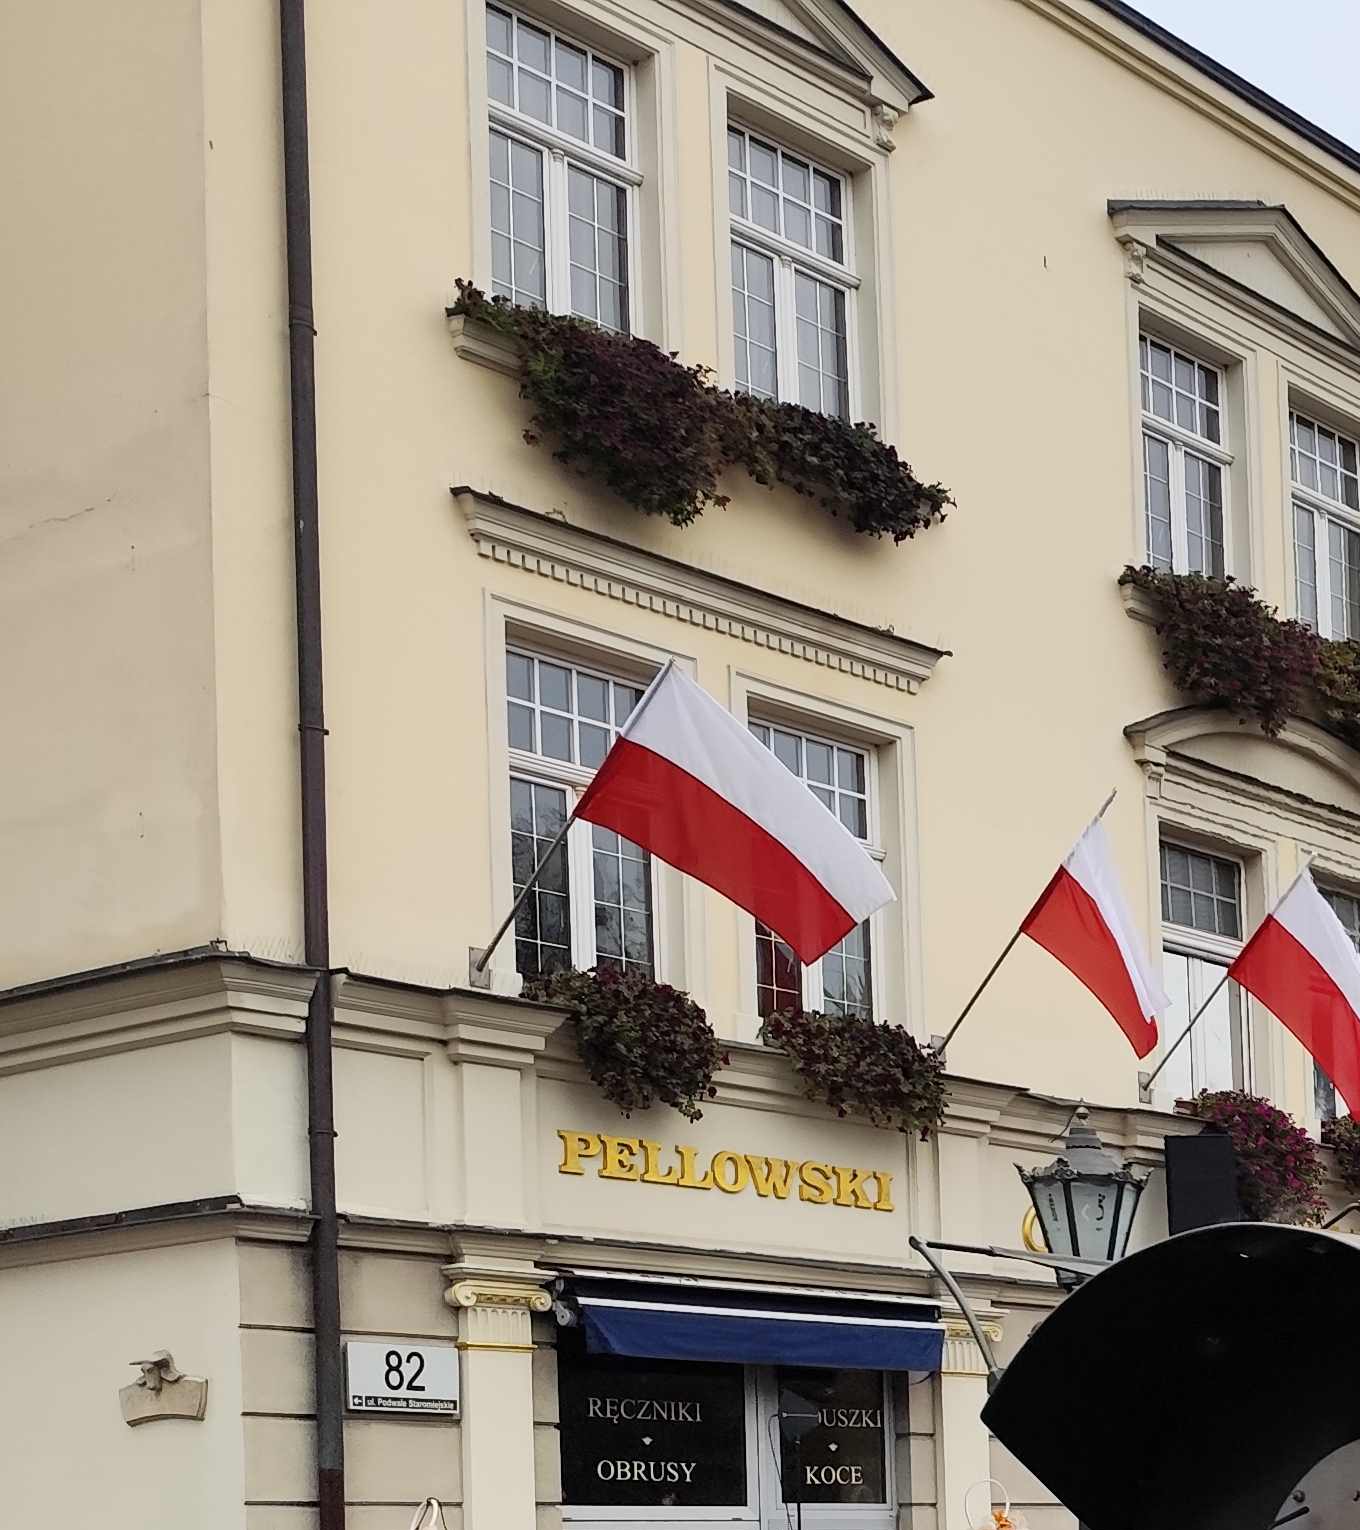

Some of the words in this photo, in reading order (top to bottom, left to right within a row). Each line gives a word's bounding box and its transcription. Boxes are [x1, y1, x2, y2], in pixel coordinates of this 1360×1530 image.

[558, 1129, 895, 1212] PELLOWSKI
[384, 1350, 425, 1391] 82
[588, 1397, 703, 1423] RĘCZNIKI
[596, 1459, 697, 1483] OBRUSY
[805, 1465, 864, 1485] KOCE
